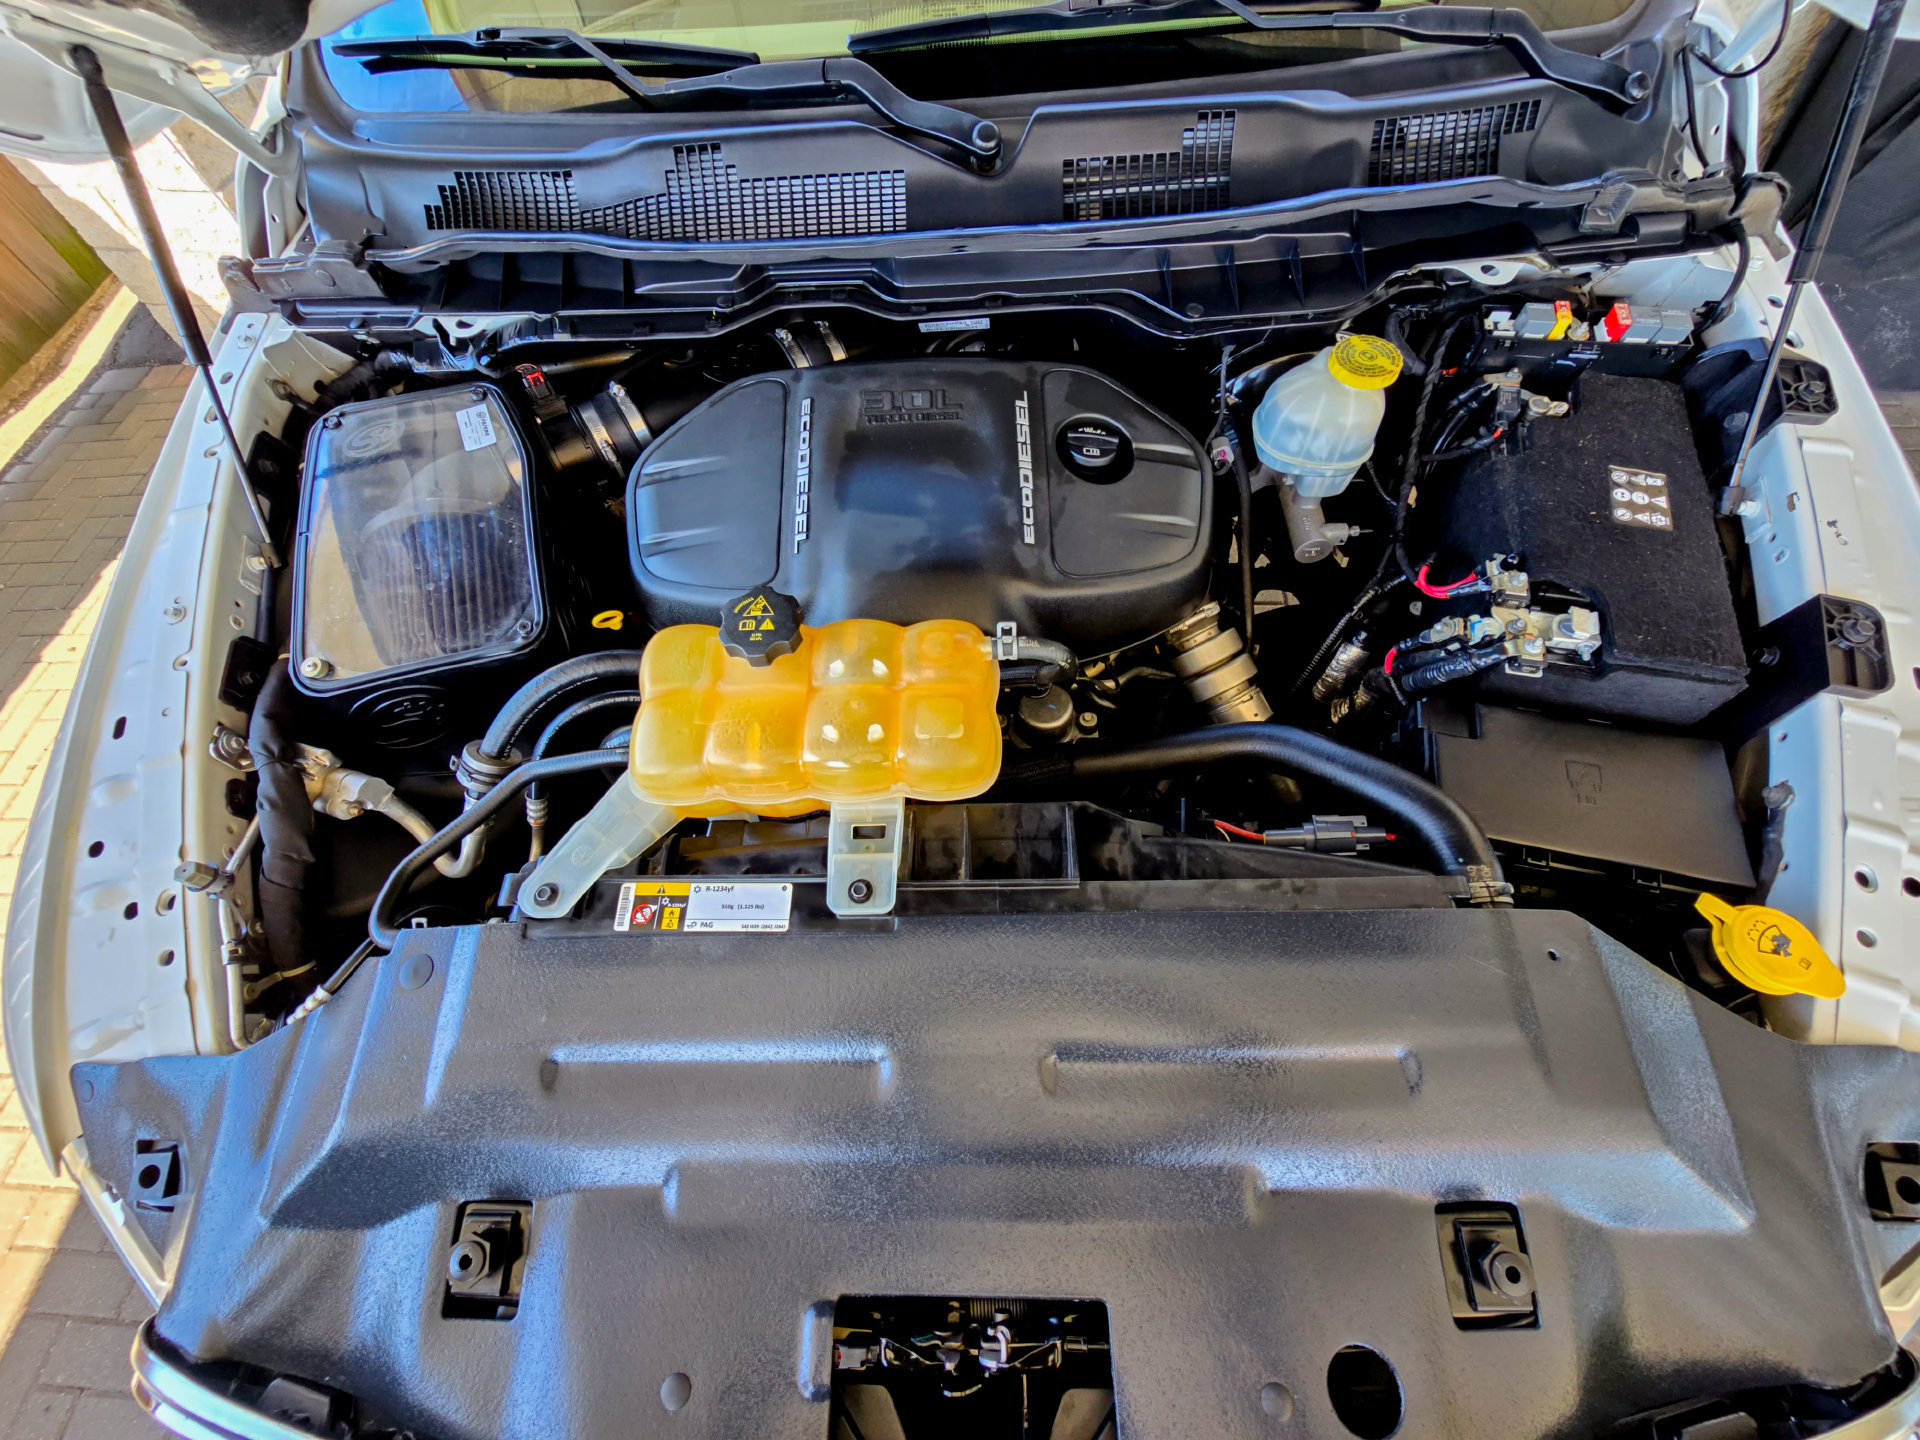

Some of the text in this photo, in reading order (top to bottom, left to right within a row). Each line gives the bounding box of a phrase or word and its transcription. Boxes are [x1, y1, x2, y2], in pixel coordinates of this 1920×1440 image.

[862, 389, 963, 412] 3.0L
[794, 398, 811, 554] ECODIESEL
[1015, 390, 1035, 544] ECODIESEL
[705, 885, 735, 893] R-1234yf
[700, 921, 714, 929] PAG
